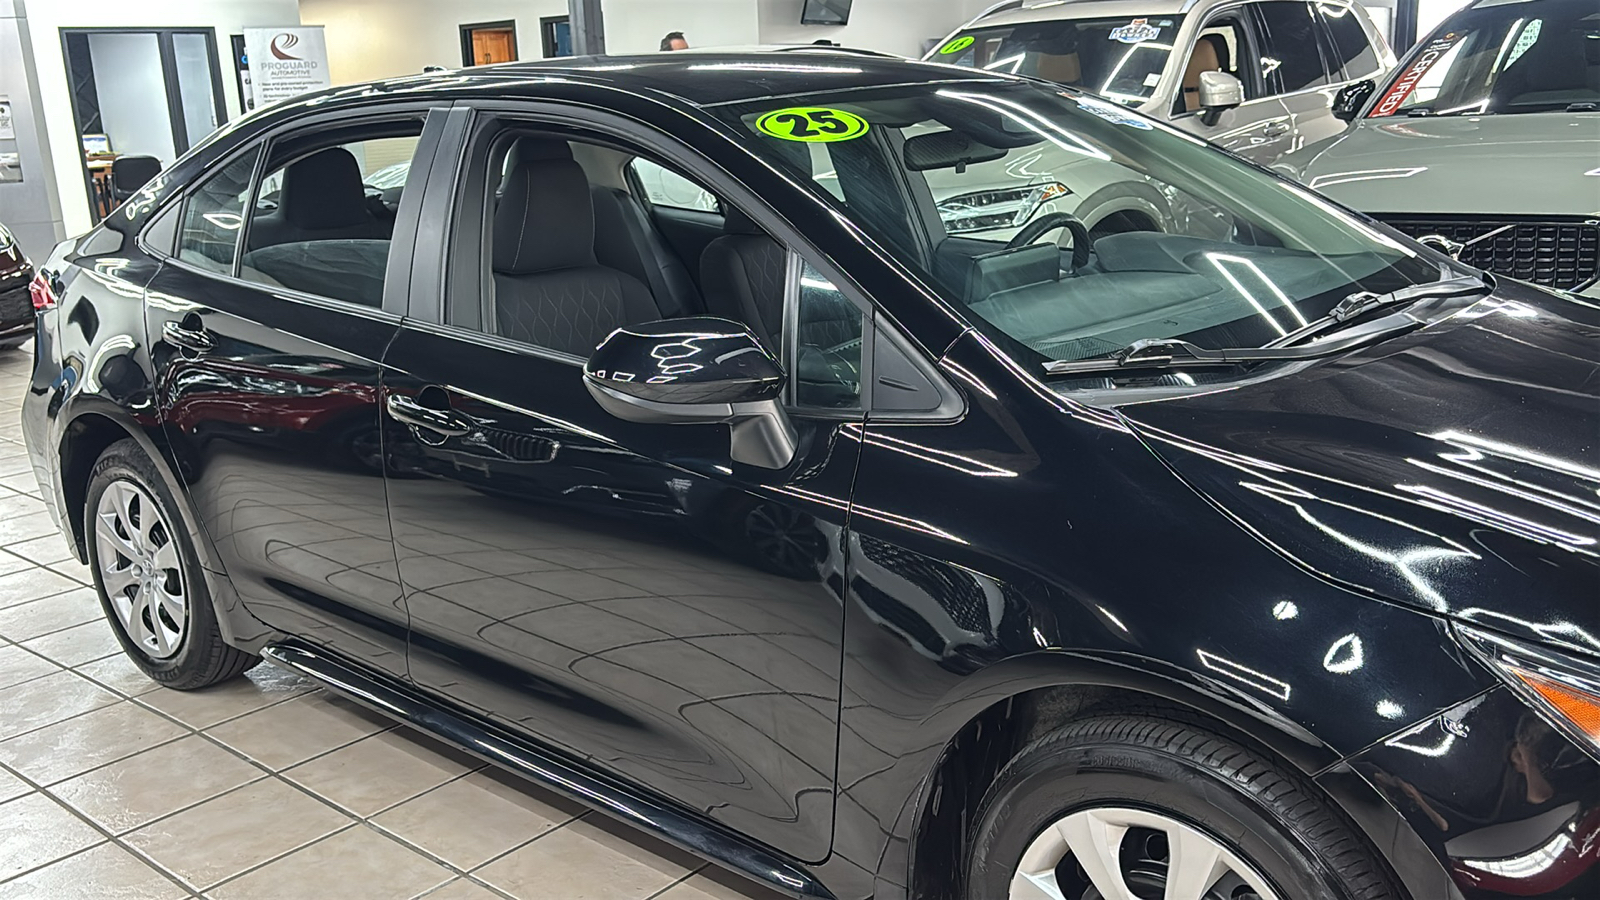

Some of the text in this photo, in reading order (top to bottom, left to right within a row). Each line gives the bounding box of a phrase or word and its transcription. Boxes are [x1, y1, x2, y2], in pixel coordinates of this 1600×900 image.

[260, 61, 318, 70] PROGUARD
[1379, 51, 1439, 113] CERTIFIED
[776, 110, 849, 137] 25
